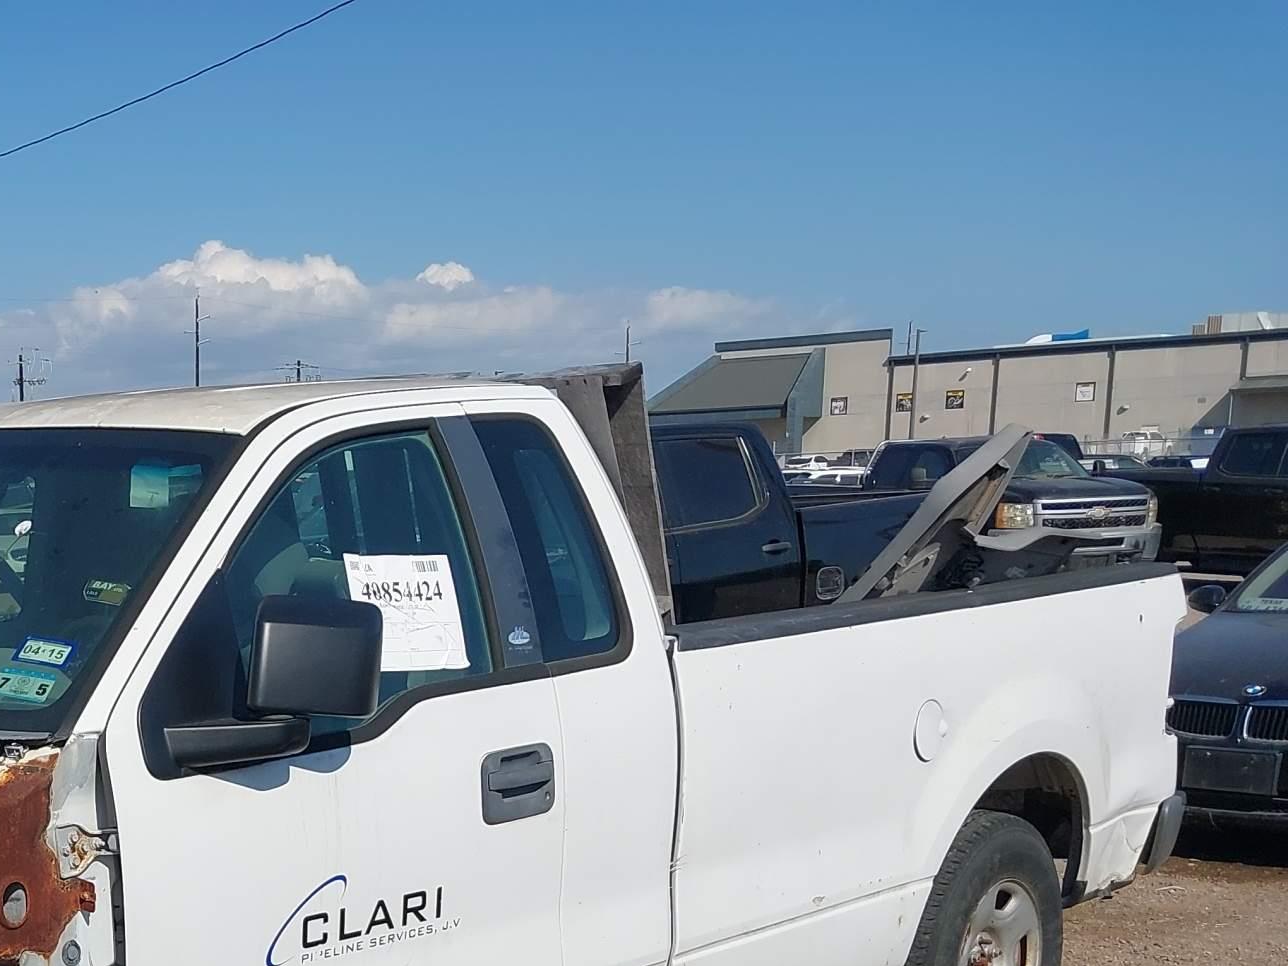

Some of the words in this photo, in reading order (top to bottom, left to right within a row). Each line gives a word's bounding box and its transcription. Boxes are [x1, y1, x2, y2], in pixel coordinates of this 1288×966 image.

[92, 580, 115, 591] BAY
[361, 580, 443, 603] 40854424
[23, 645, 42, 656] 04
[48, 648, 66, 660] 15
[302, 886, 443, 949] CLARI
